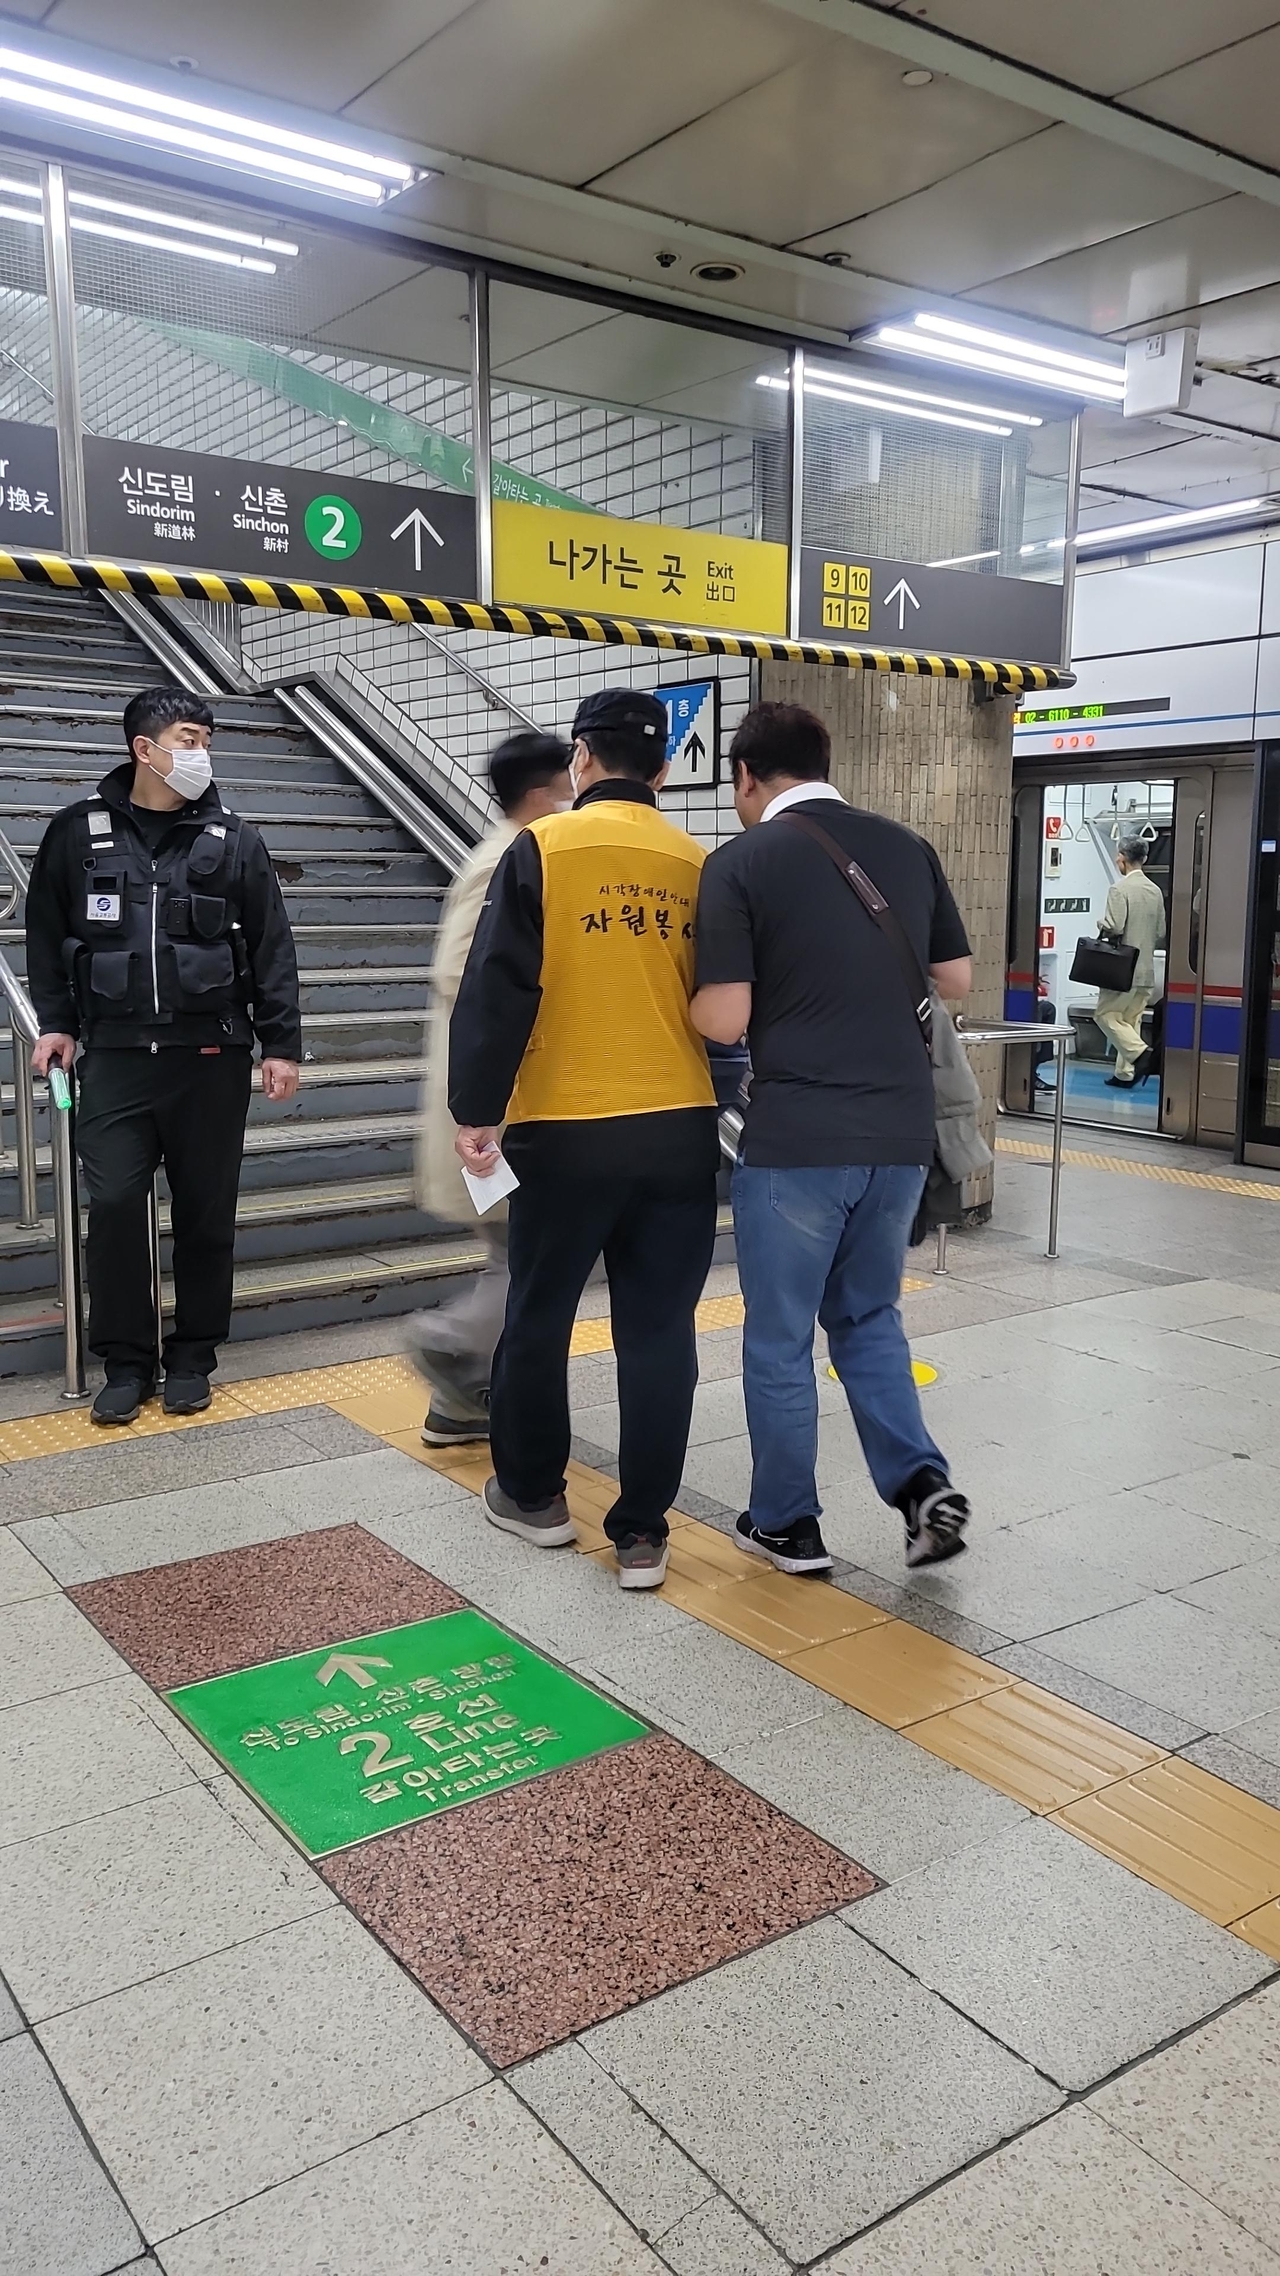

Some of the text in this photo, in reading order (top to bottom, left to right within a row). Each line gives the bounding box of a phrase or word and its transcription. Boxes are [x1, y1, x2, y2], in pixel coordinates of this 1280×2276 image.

[118, 466, 194, 504] 신도림
[240, 485, 289, 517] 신촌
[126, 498, 289, 535] Sindorim Sinchon
[321, 505, 347, 549] 2
[153, 521, 290, 554] 新道林 新村
[549, 539, 687, 596] 나가는 곳
[707, 560, 735, 581] Exit
[830, 568, 869, 592] 9 10
[706, 581, 736, 603] 出口
[826, 602, 868, 625] 11 12
[264, 1735, 299, 1753] To
[419, 1713, 521, 1754] Line
[340, 1730, 414, 1779] 2
[416, 1753, 539, 1803] Transfer
